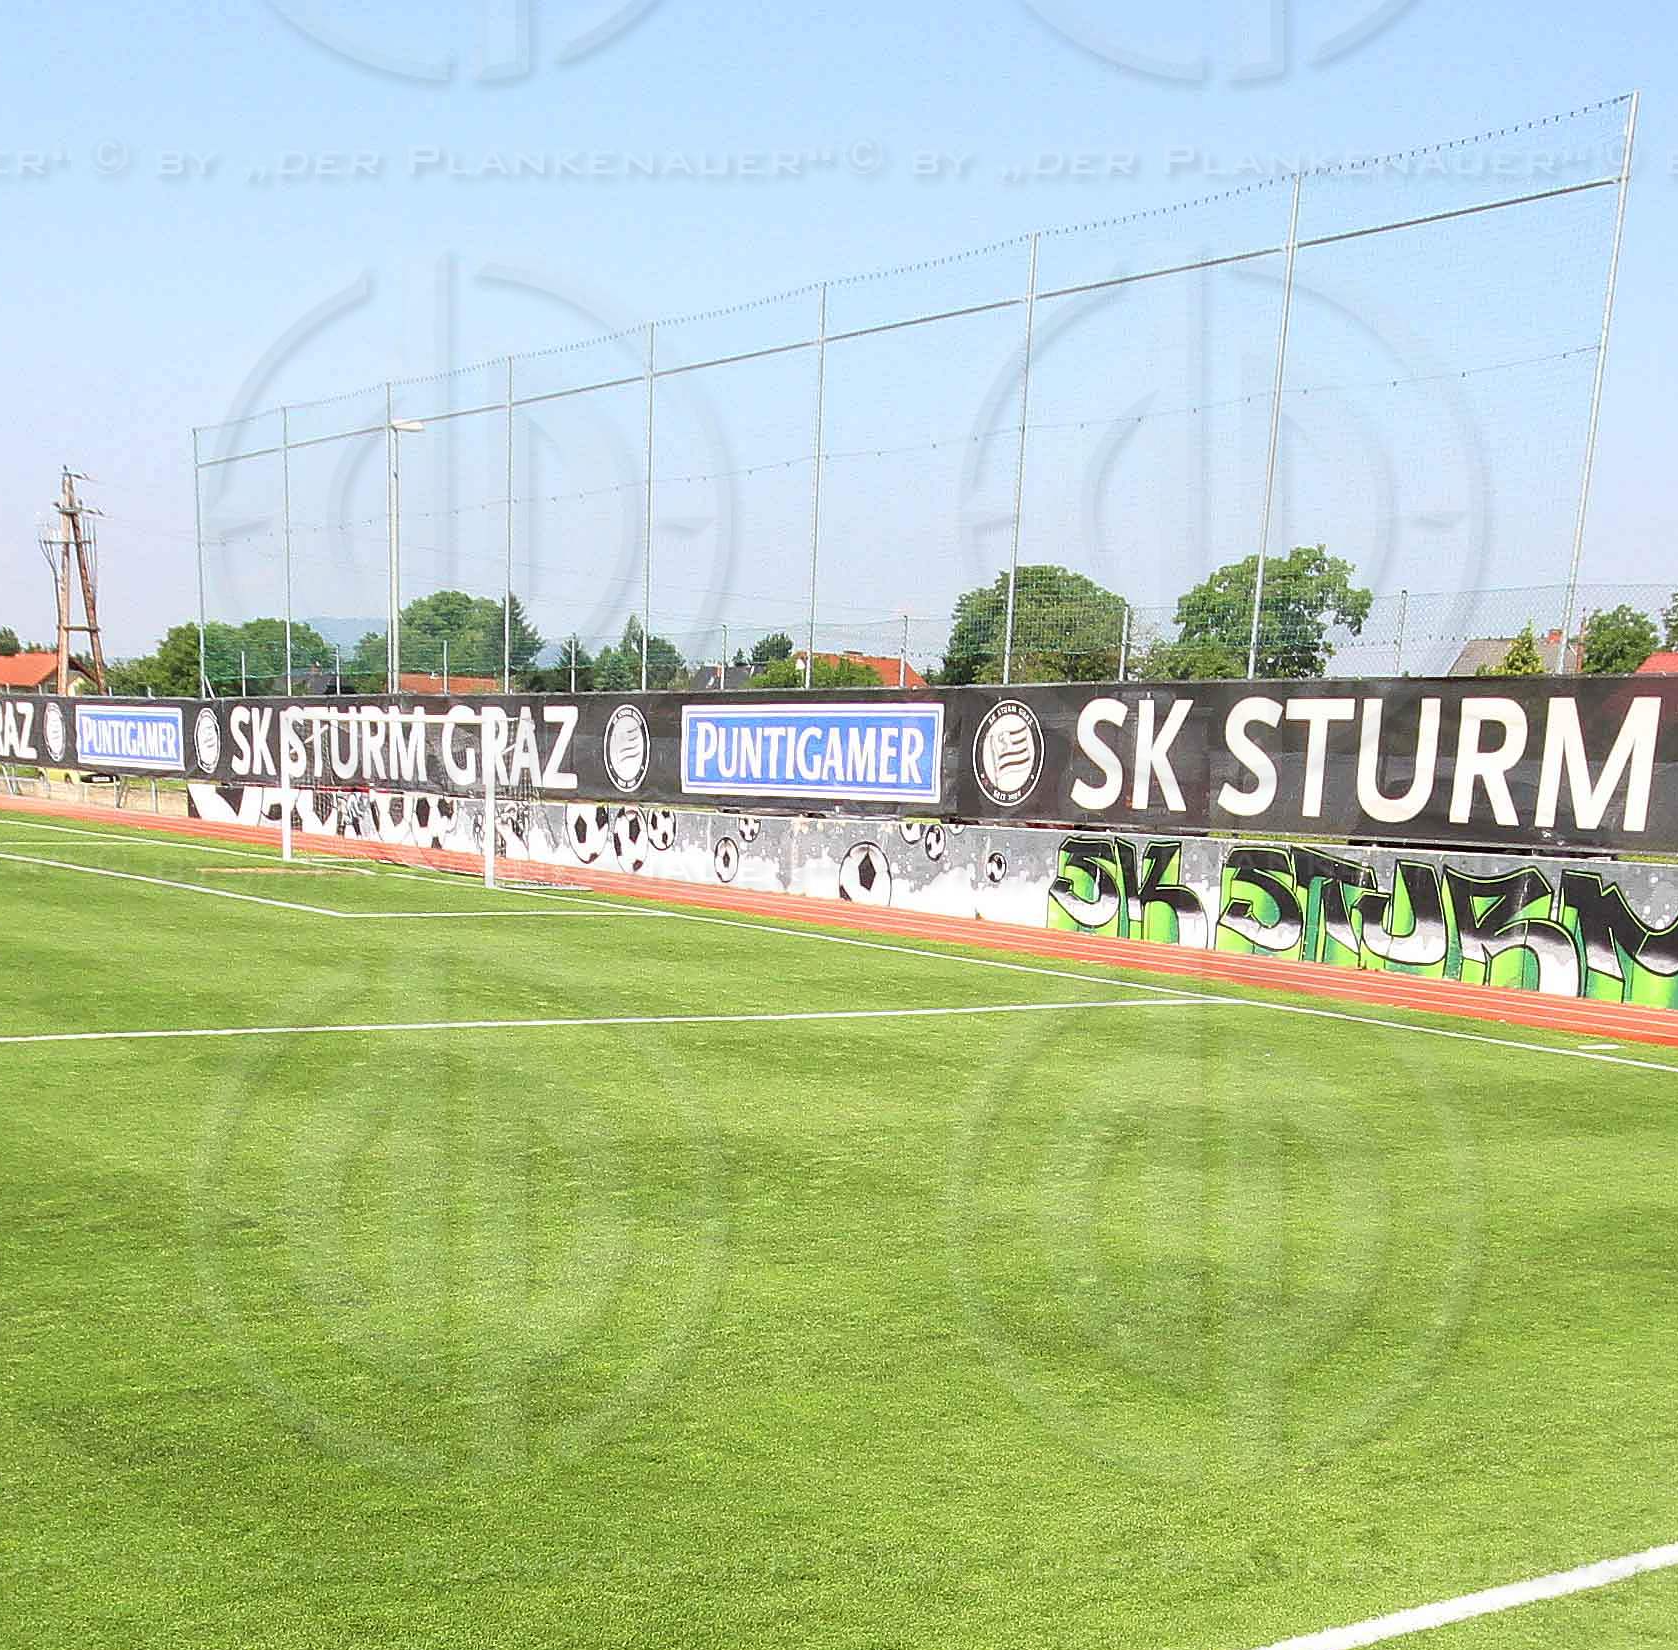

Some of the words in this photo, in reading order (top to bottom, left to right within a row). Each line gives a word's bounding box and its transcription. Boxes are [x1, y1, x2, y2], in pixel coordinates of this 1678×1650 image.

[82, 717, 179, 759] PUNTIGAMER
[230, 705, 277, 777] SK
[282, 705, 428, 783] STURM
[441, 705, 579, 790] GRAZ
[694, 723, 924, 787] PUNTIGAMER
[1070, 697, 1195, 813] SK
[1216, 695, 1664, 835] STURM
[1047, 837, 1210, 948] SK
